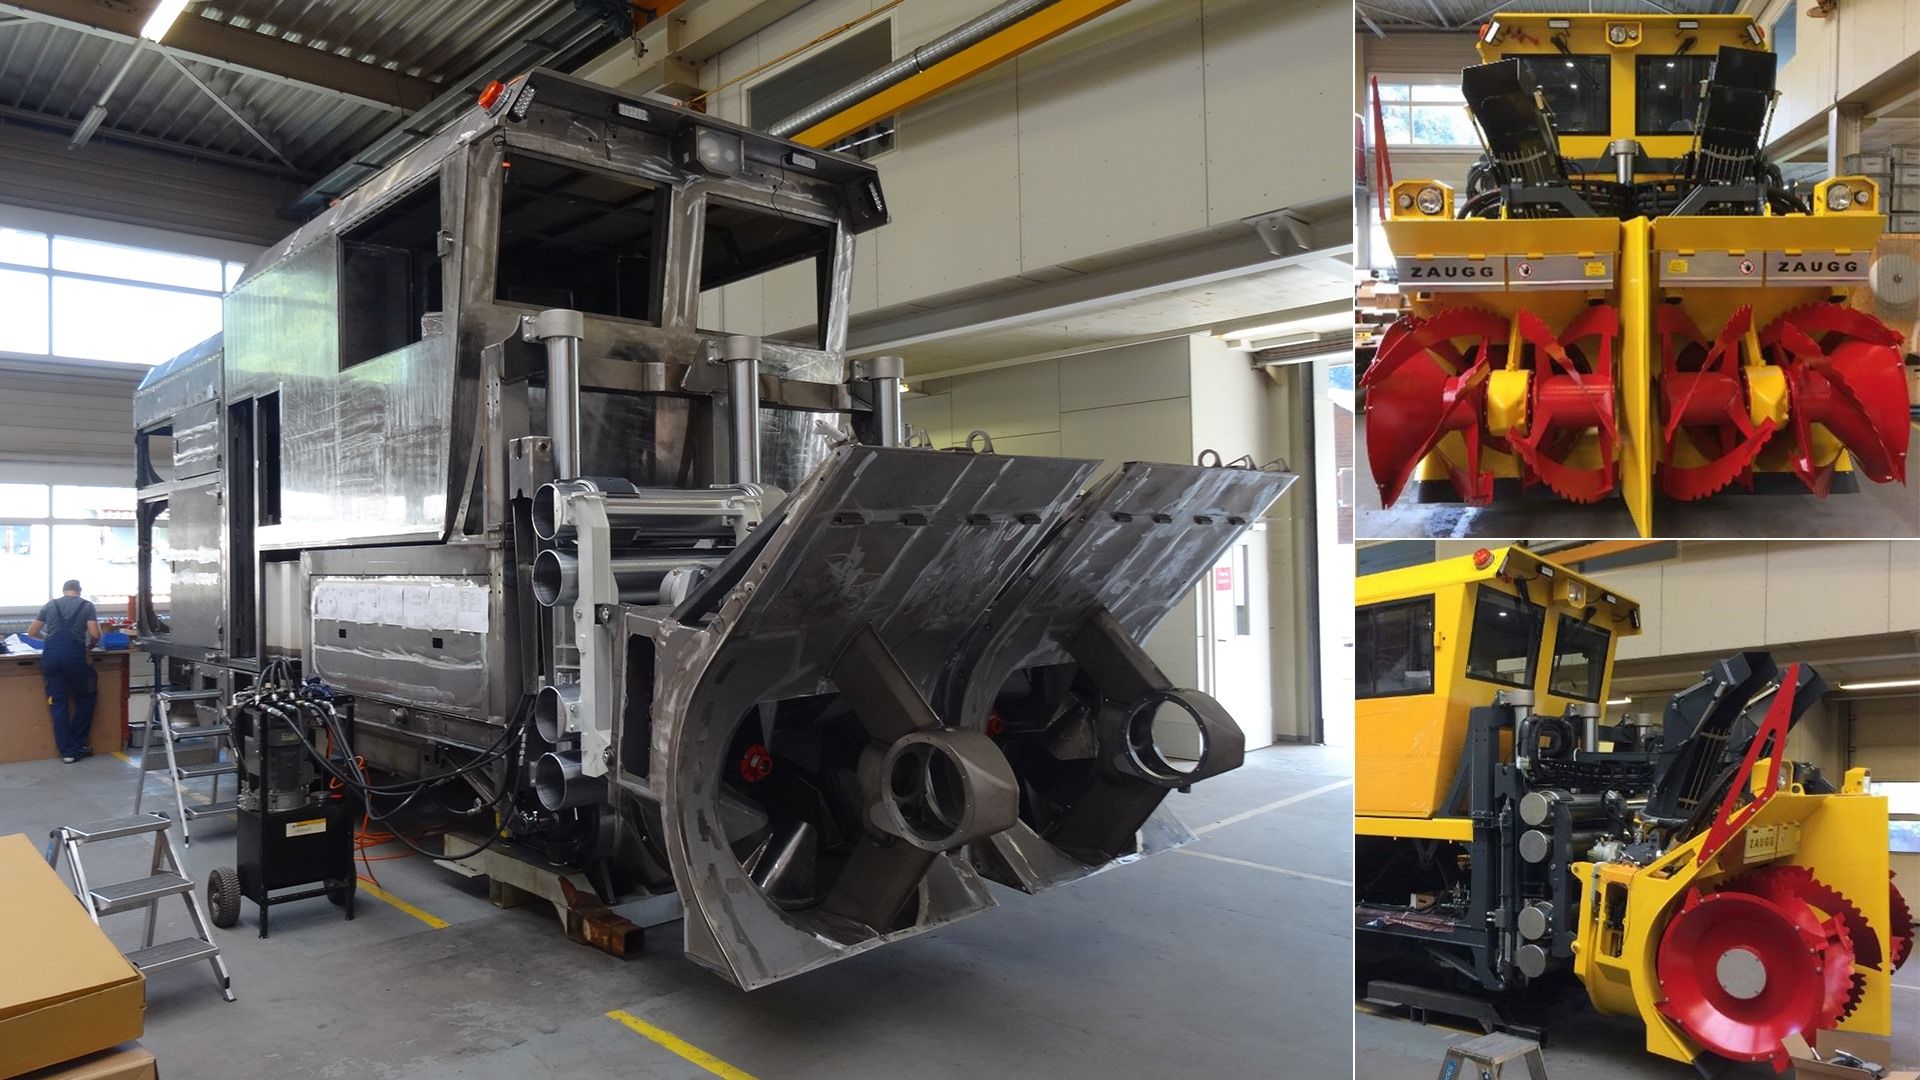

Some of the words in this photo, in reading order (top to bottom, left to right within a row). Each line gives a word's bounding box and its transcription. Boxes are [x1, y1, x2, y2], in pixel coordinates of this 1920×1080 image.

[1410, 266, 1494, 278] ZAUGG
[1777, 261, 1857, 272] ZAUGG
[1749, 836, 1775, 849] ZAUGG
